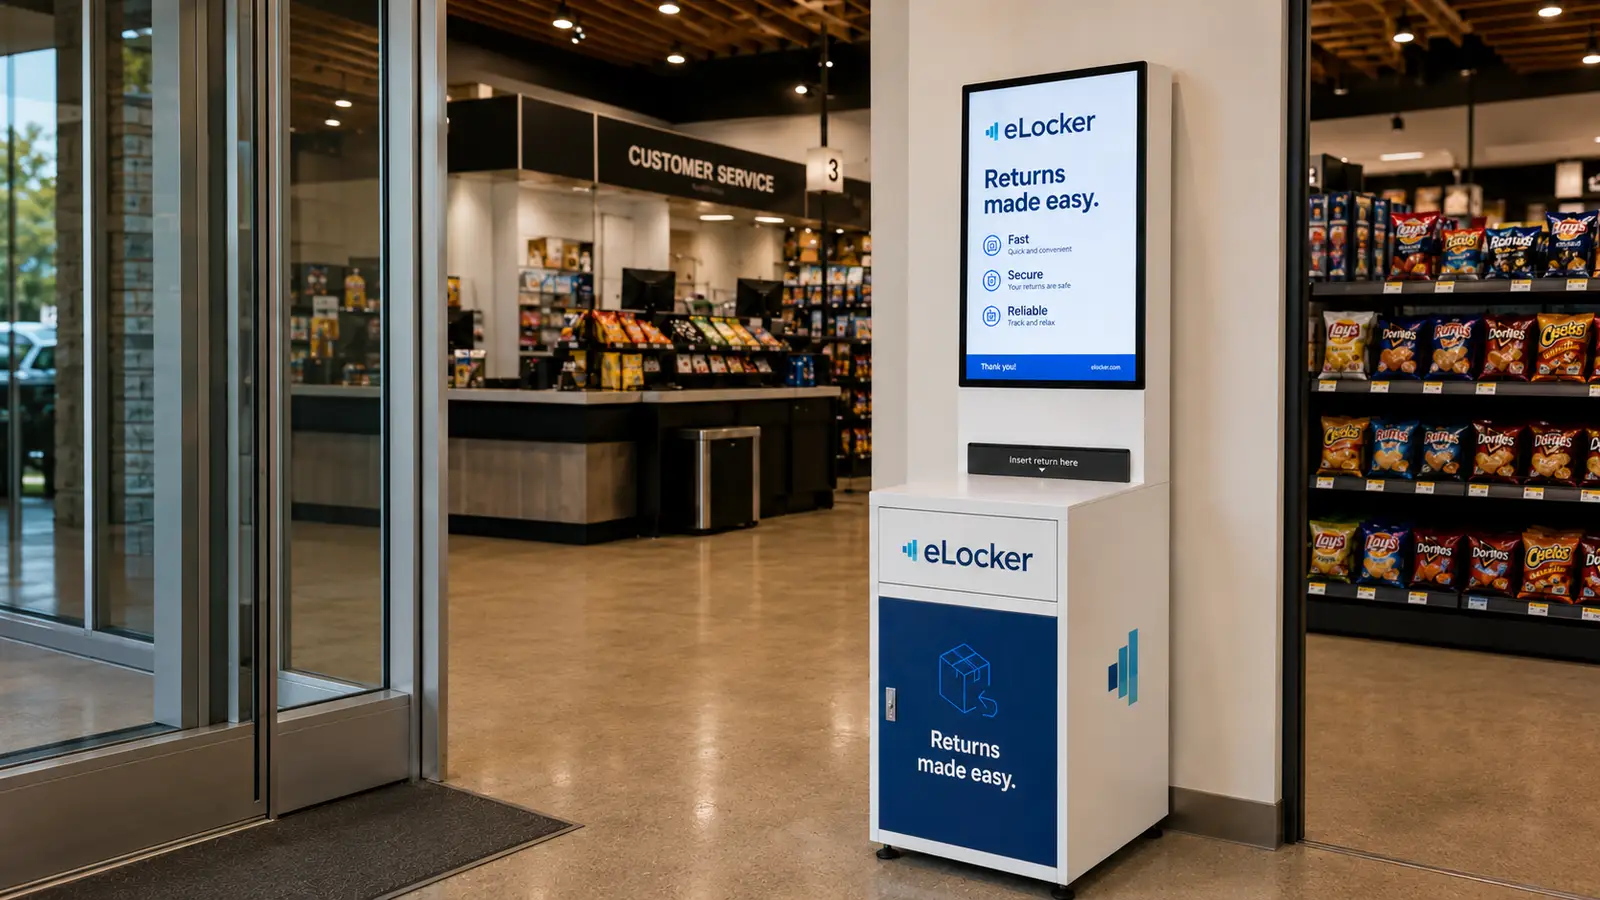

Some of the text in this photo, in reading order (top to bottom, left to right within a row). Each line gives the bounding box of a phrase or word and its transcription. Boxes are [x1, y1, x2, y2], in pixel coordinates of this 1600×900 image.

[1004, 113, 1096, 139] eLocker
[628, 145, 775, 193] CUSTOMER SERVICE
[828, 158, 839, 182] 3
[984, 167, 1066, 189] Returns
[984, 192, 1099, 214] made easy.
[1008, 234, 1030, 245] Fast
[1007, 248, 1025, 256] Quick
[1038, 245, 1072, 254] convenient
[1007, 269, 1044, 280] Secure
[1007, 283, 1022, 291] Your
[1058, 281, 1071, 289] safe
[1007, 305, 1048, 316] Reliable
[1007, 318, 1055, 327] Track and relax
[980, 362, 1017, 372] Thank you!
[1009, 455, 1079, 467] Insert return here
[924, 540, 1033, 572] eLocker
[930, 729, 1000, 759] Returns
[917, 756, 1016, 792] made easy.
